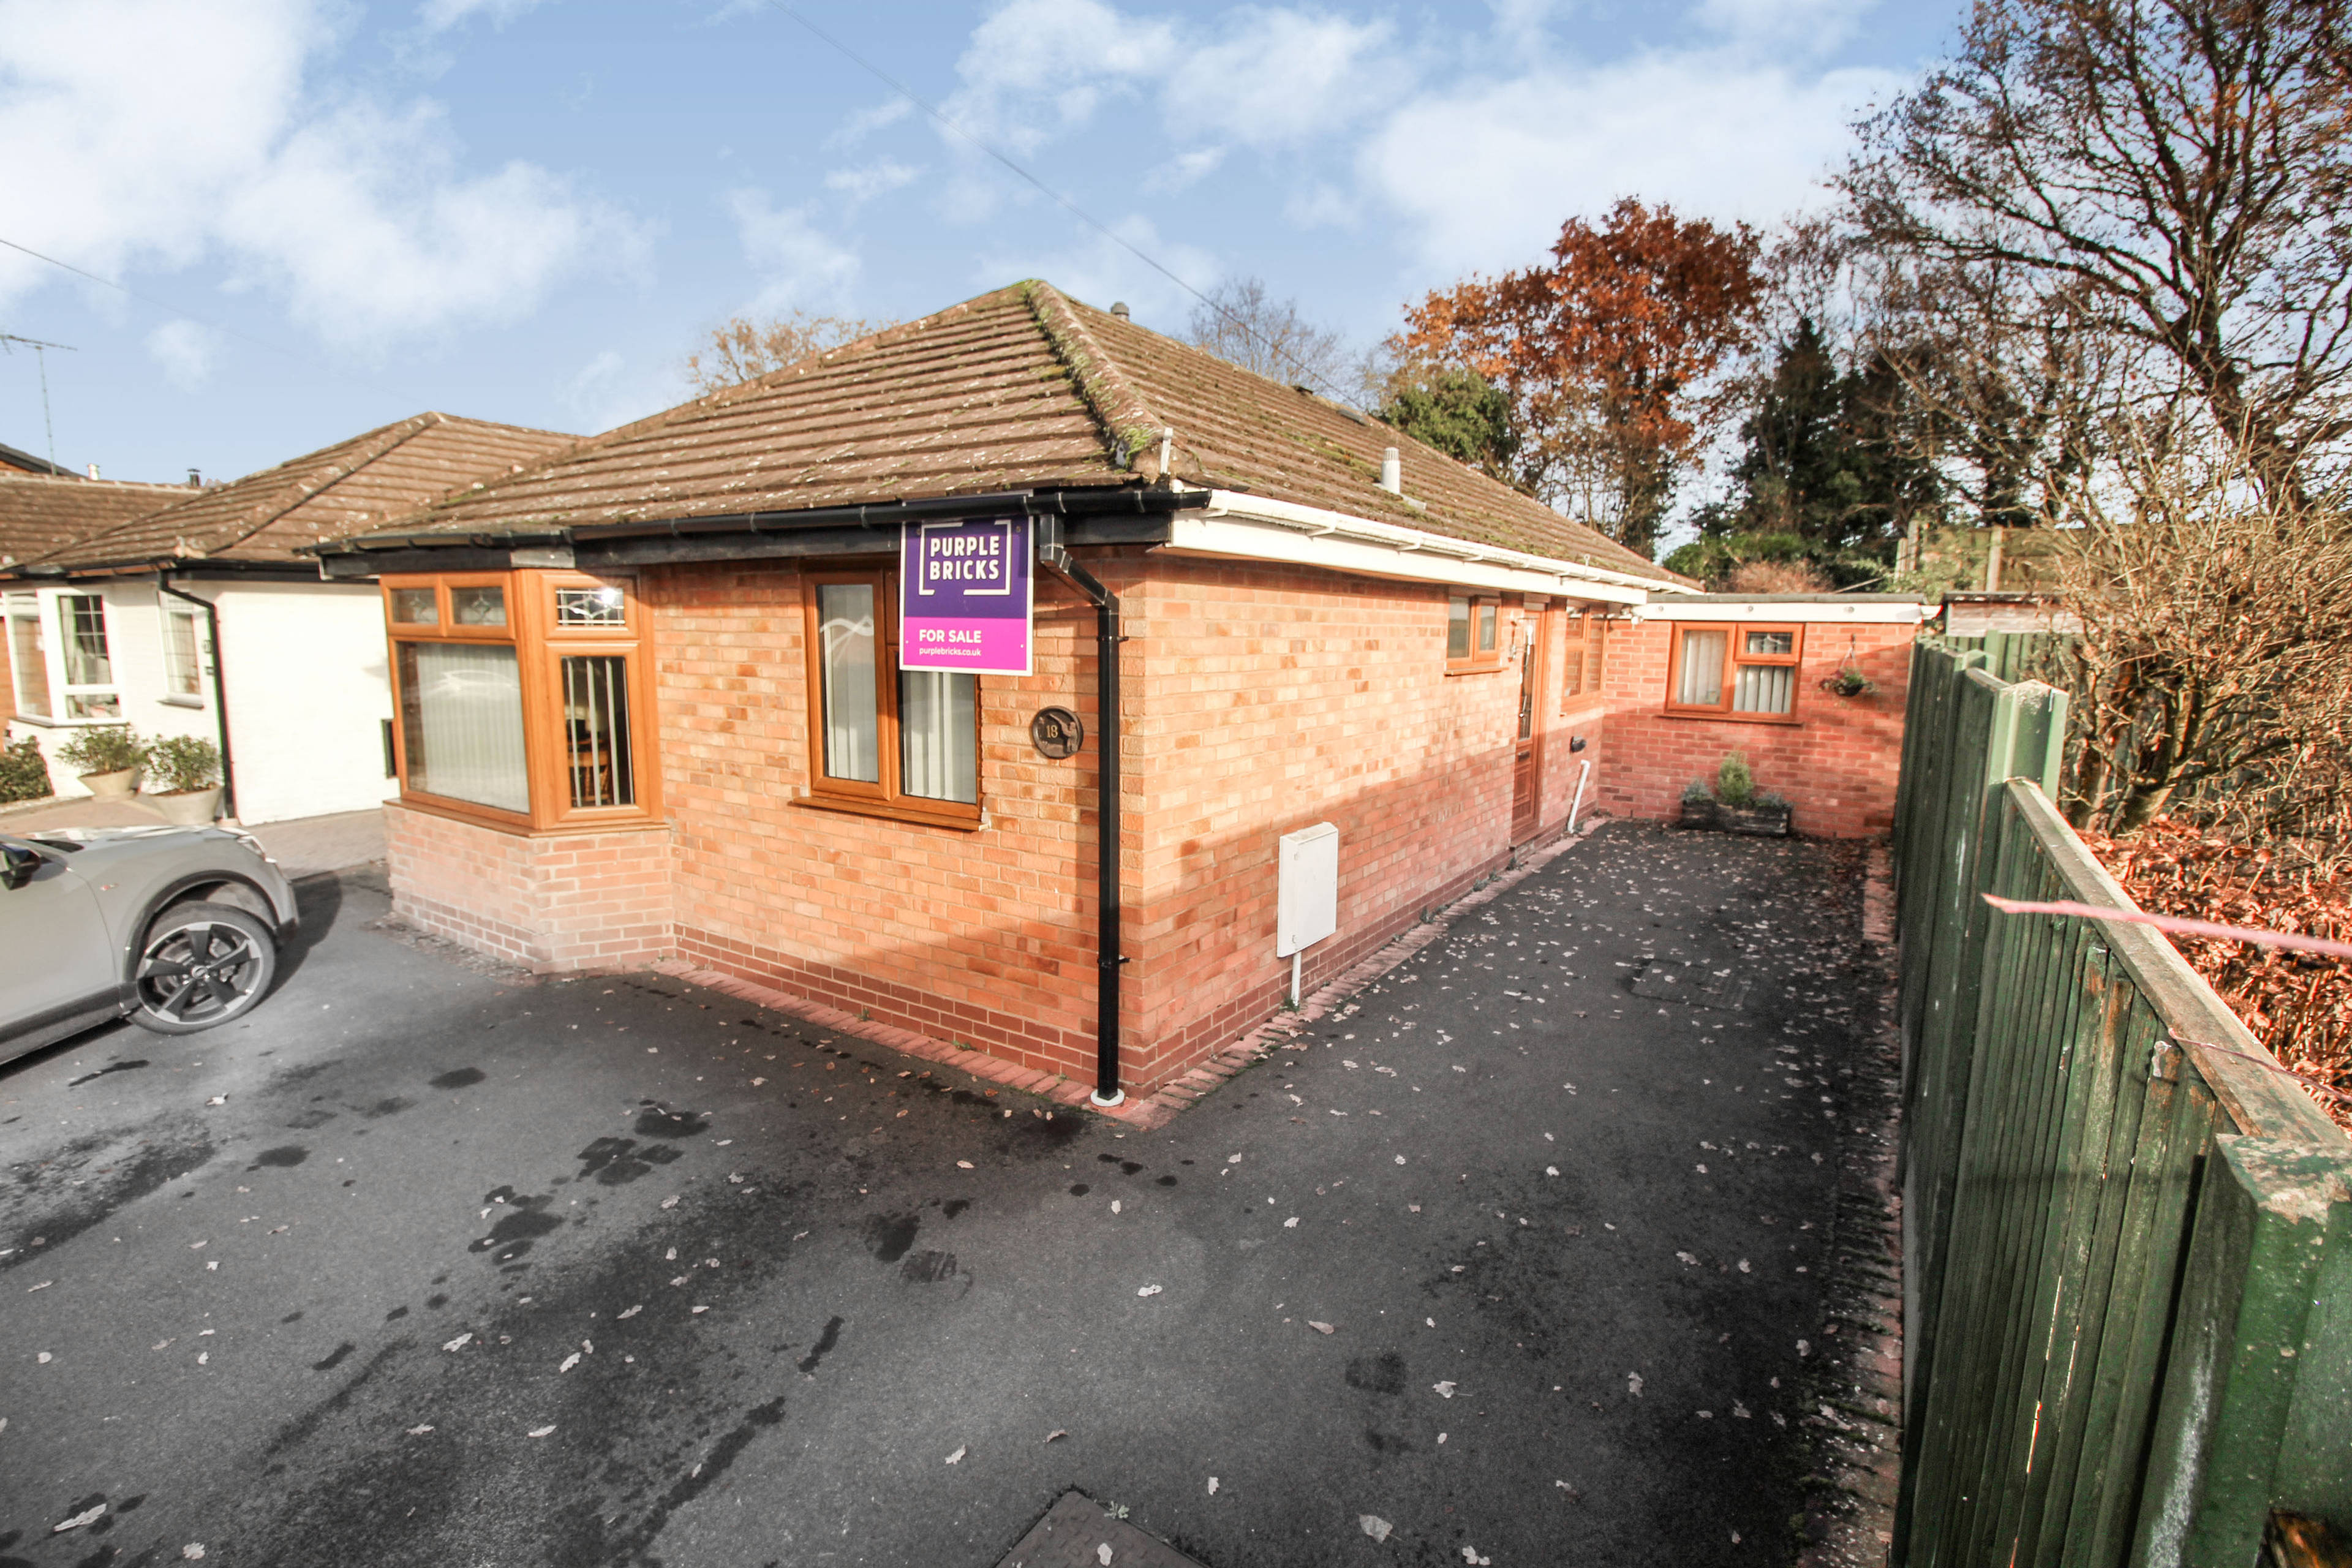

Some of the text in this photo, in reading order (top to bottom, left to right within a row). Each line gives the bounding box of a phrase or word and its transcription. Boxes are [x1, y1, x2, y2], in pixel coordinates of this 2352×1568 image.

[930, 535, 1000, 557] PURPLE
[929, 559, 1000, 580] BRICKS
[919, 629, 982, 643] FOR SALE
[919, 647, 981, 656] purplebricks.co.uk
[1046, 725, 1058, 738] 18
